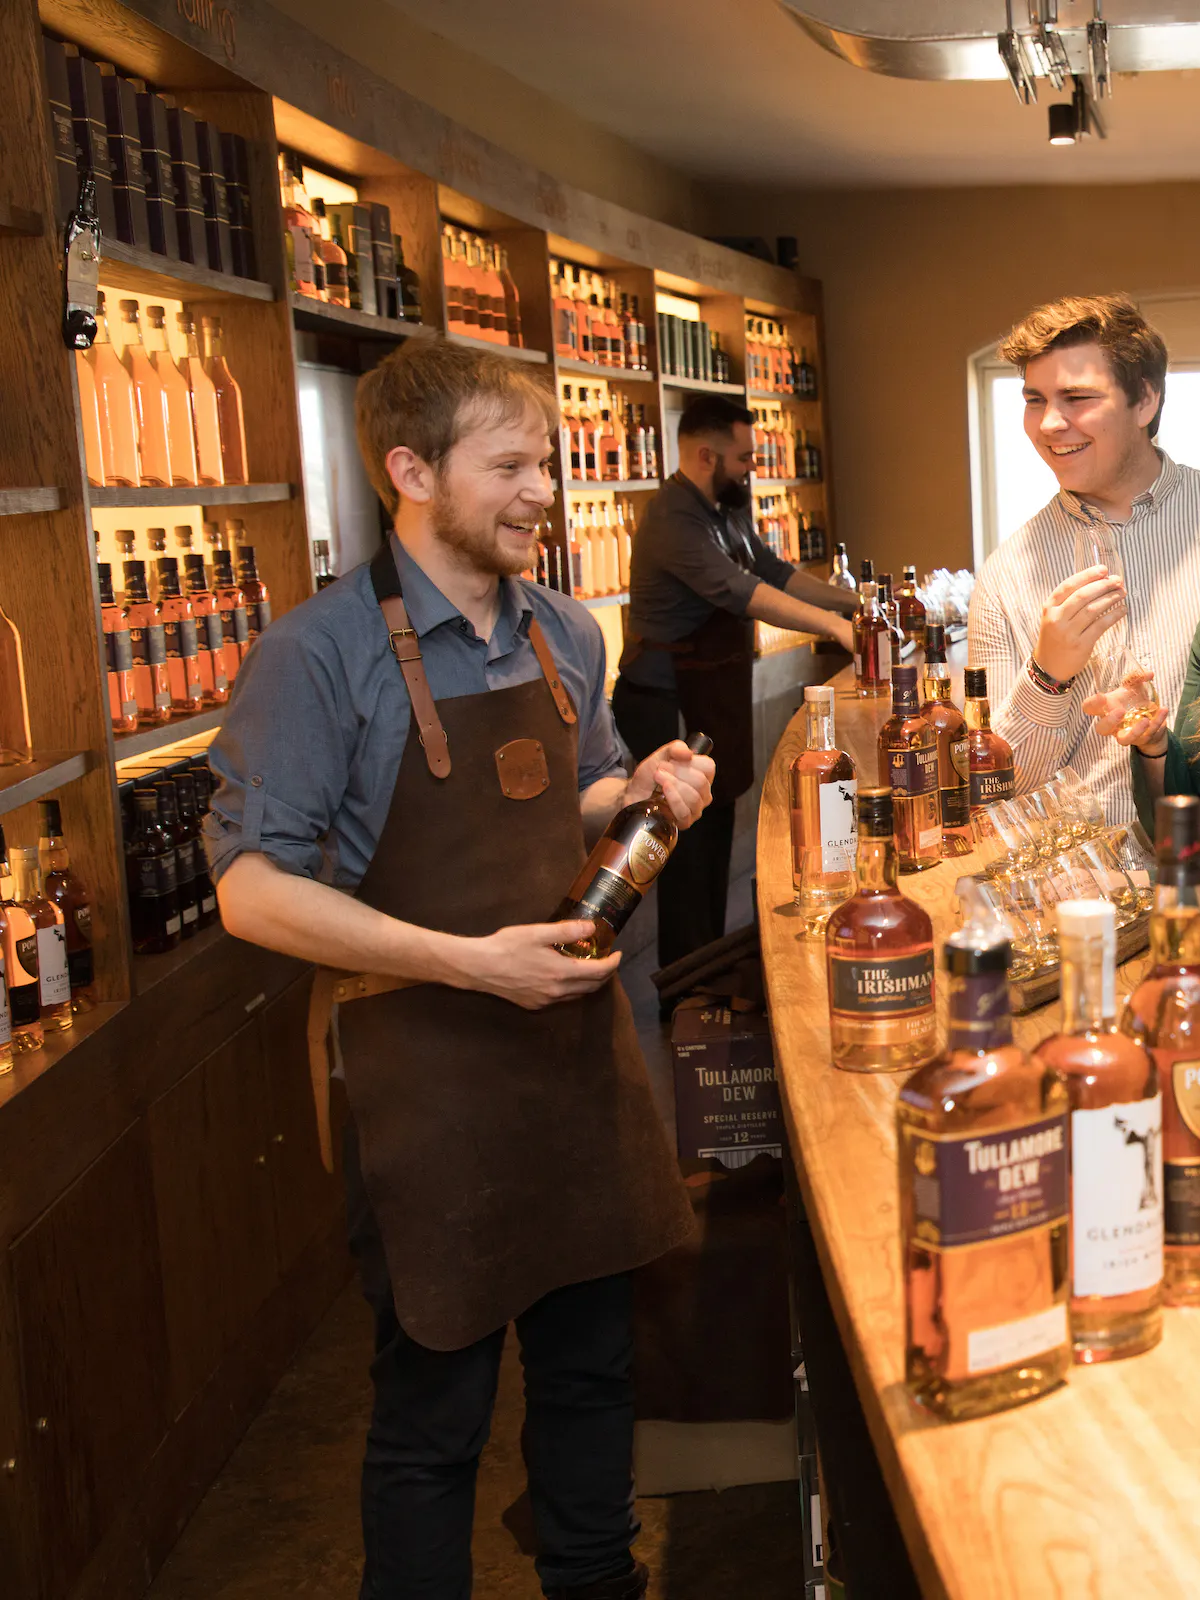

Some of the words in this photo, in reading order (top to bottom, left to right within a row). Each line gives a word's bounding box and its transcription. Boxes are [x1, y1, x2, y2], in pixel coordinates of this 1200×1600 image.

[983, 777, 1000, 785] THE
[861, 969, 890, 980] THE
[857, 970, 933, 995] IRISHMAN
[723, 1086, 756, 1102] DEW
[703, 1114, 737, 1124] SPECIAL
[741, 1111, 777, 1120] RESERVE
[733, 1131, 749, 1143] 12
[998, 1159, 1040, 1192] DEW
